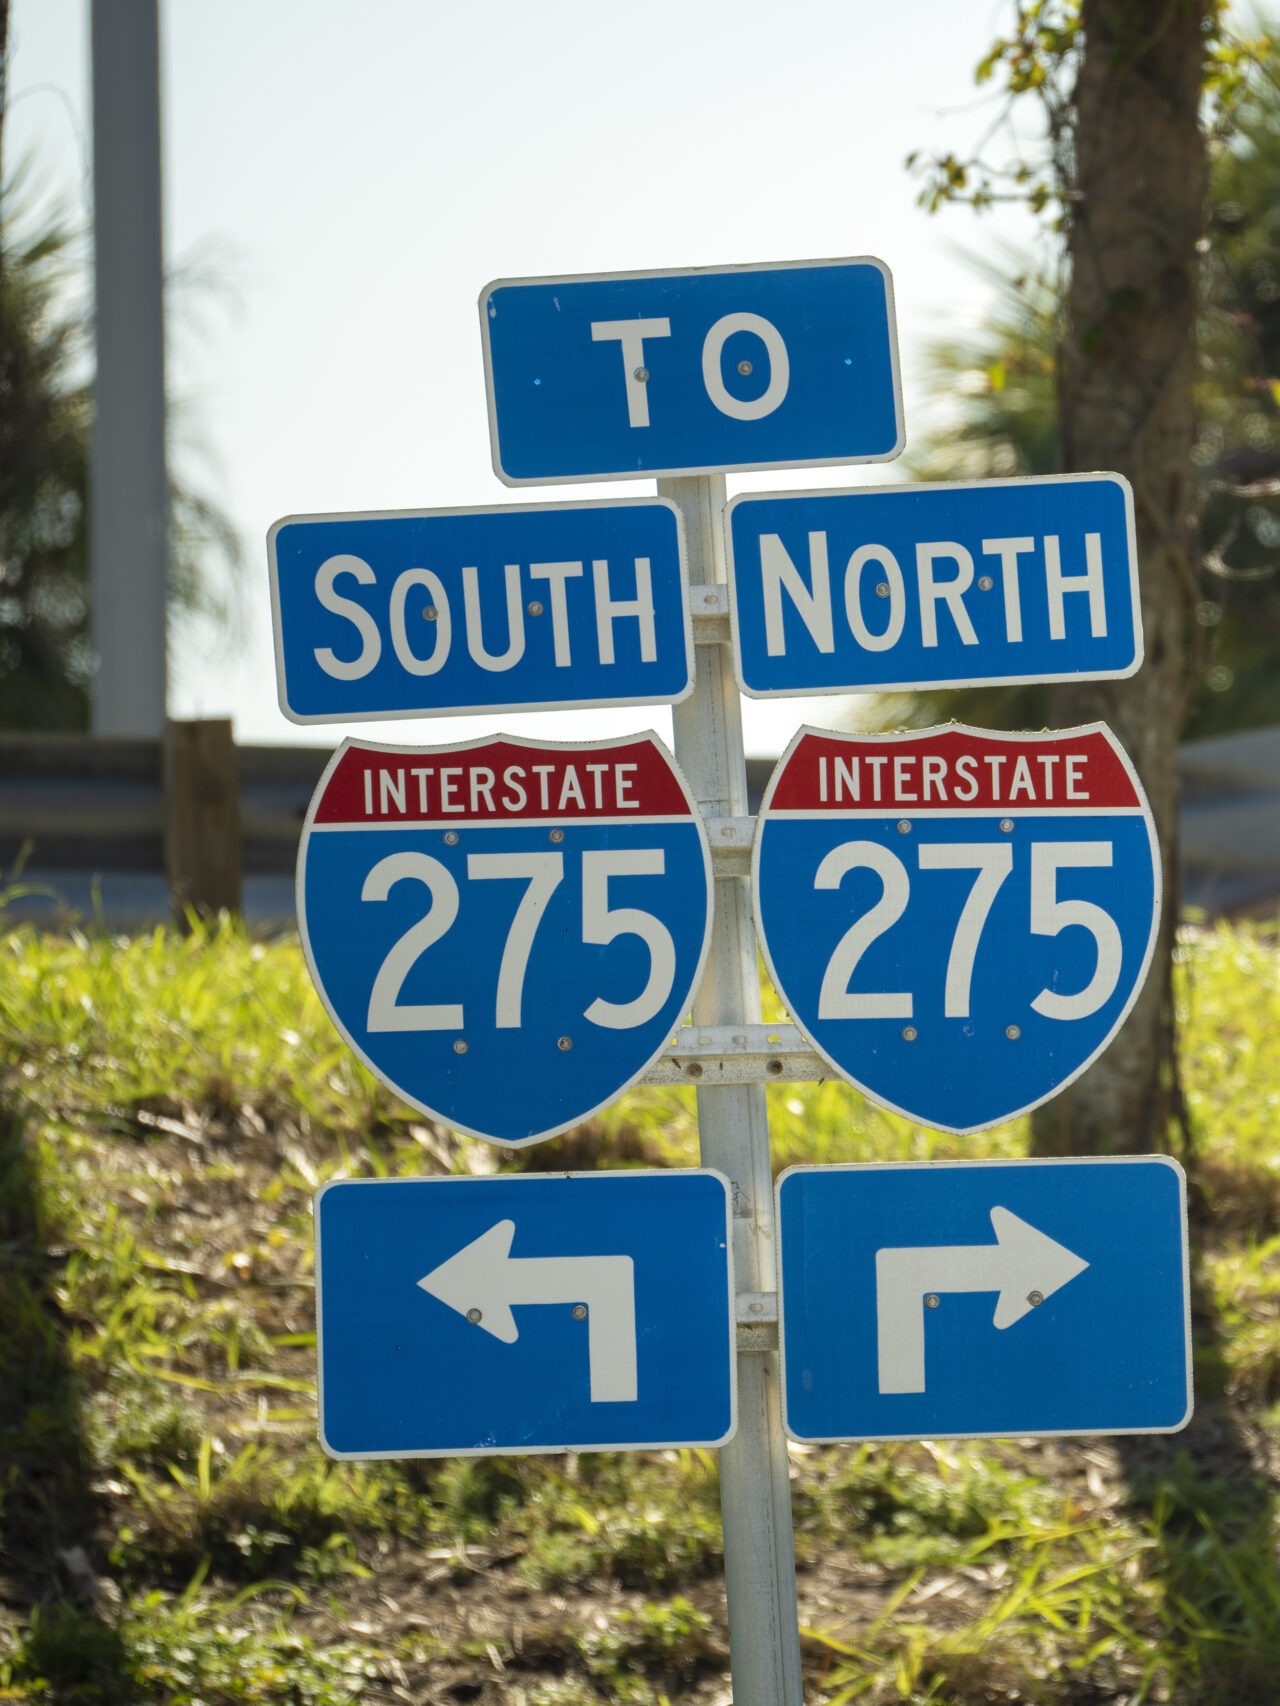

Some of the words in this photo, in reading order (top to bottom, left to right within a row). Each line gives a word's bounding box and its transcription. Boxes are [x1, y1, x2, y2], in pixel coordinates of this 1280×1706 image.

[591, 312, 790, 428] TO
[313, 554, 658, 681] SOUTH
[759, 531, 1108, 657] NORTH
[364, 763, 640, 815] INTERSTATE
[819, 755, 1089, 802] INTERSTATE
[361, 848, 676, 1033] 275
[814, 840, 1123, 1021] 275
